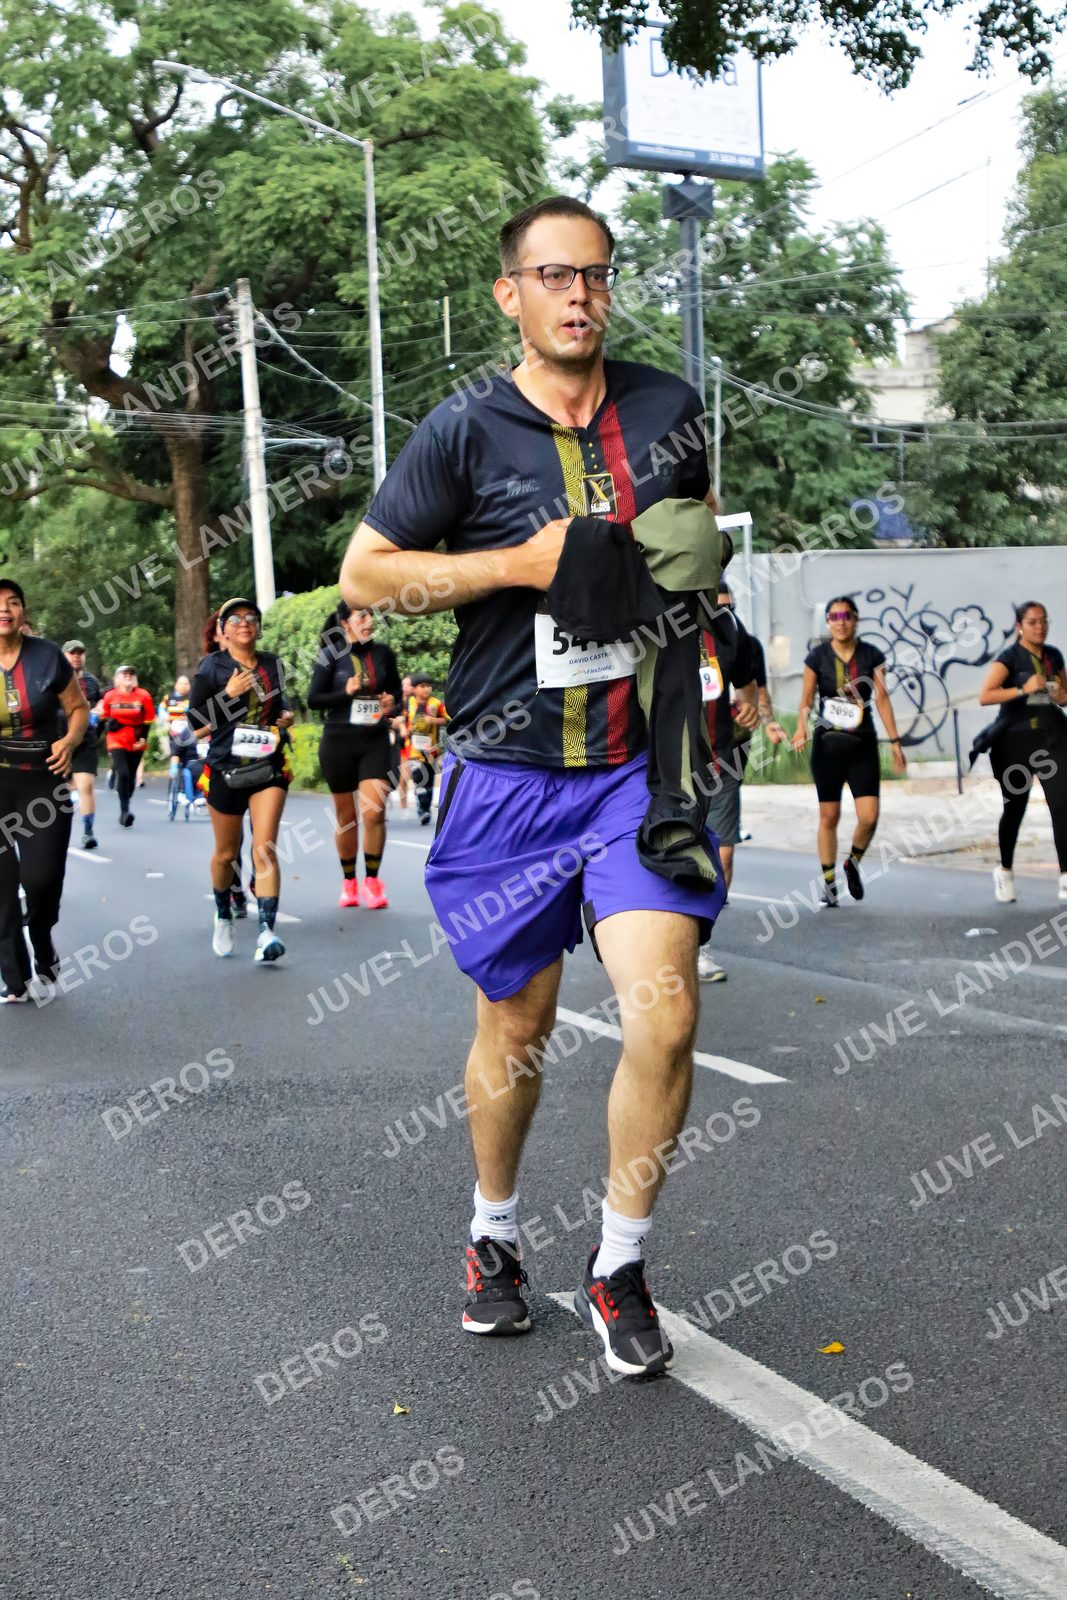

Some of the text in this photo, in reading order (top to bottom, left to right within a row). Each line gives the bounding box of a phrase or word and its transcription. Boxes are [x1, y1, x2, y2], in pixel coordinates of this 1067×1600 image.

[568, 651, 613, 665] DAVID CASTRO
[356, 703, 380, 714] 5918
[239, 733, 270, 745] 2233
